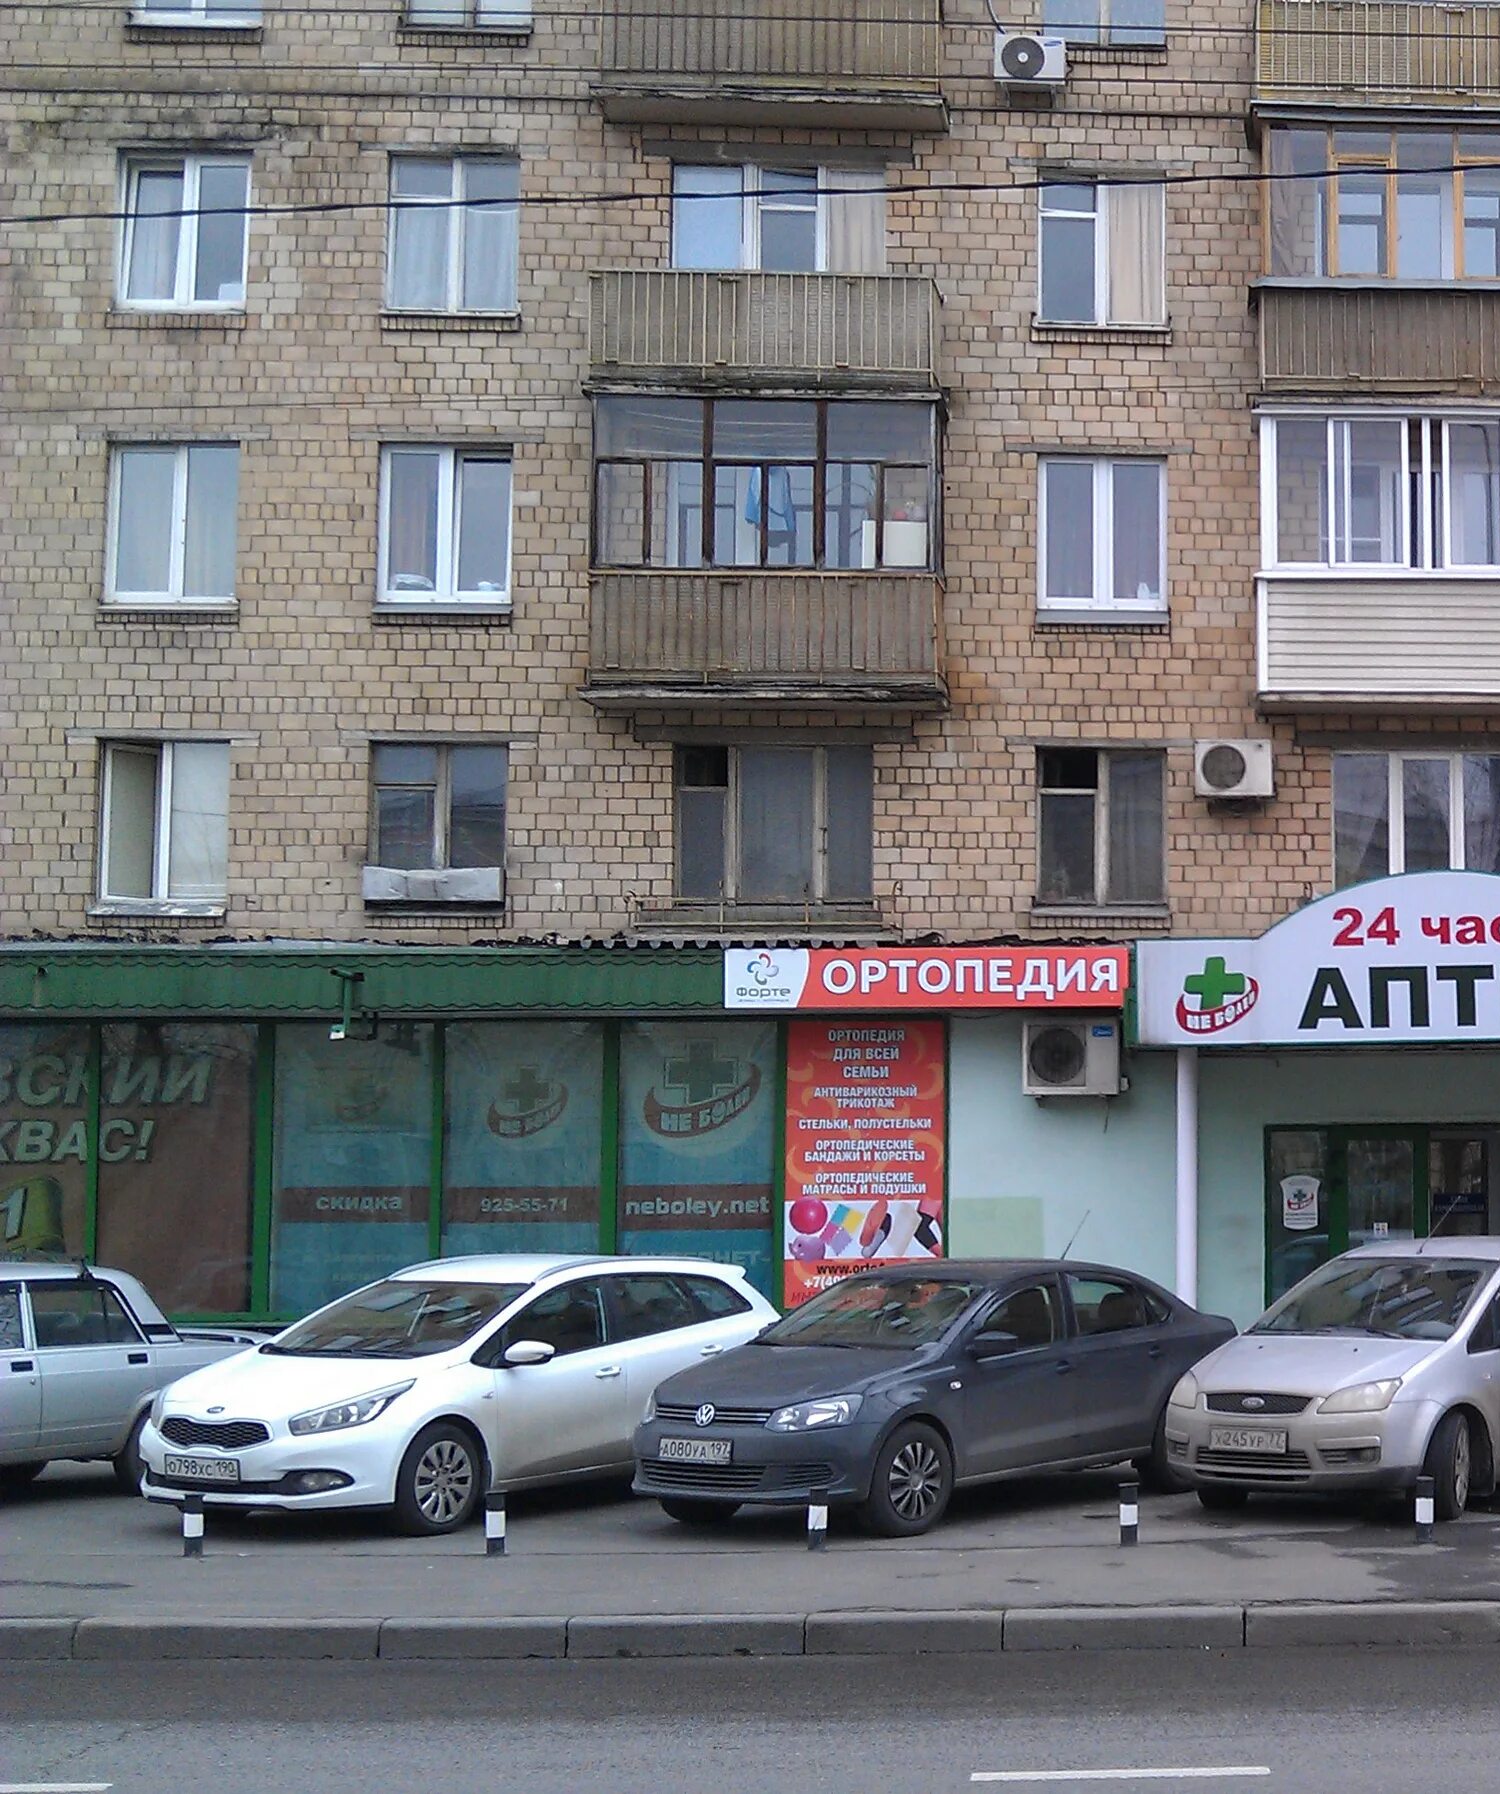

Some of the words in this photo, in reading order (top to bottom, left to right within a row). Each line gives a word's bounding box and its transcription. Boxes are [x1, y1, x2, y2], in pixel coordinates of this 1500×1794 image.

[1332, 907, 1400, 946] 24
[821, 958, 1119, 1001] ОРТОПЕДИЯ
[736, 987, 791, 998] Форте
[828, 1029, 905, 1043] ОРТОПЕДИЯ
[833, 1048, 861, 1062] ДЛЯ
[865, 1045, 900, 1060] ВСЕЙ
[843, 1066, 889, 1078] СЕМЬИ
[814, 1085, 918, 1097] АНТИВАРИКОЗНЫЙ
[837, 1098, 895, 1108] ТРИКОТАЖ
[799, 1118, 852, 1130] СТЕЛЬКИ,
[854, 1118, 932, 1129] ПОЛУСТЕЛЬКИ
[815, 1139, 915, 1151] ОРТОПЕДИЧЕСКИЕ
[804, 1151, 860, 1162] БАНДАЖИ
[863, 1151, 872, 1161] И
[874, 1150, 925, 1161] КОРСЕТЫ
[815, 1172, 915, 1184] ОРТОПЕДИЧЕСКИЕ
[802, 1184, 857, 1195] МАТРАСЫ
[860, 1184, 868, 1194] И
[871, 1183, 926, 1195] ПОДУШКИ
[316, 1195, 402, 1213] скидка
[481, 1197, 569, 1213] 925-55-71
[625, 1196, 770, 1218] neboley.net
